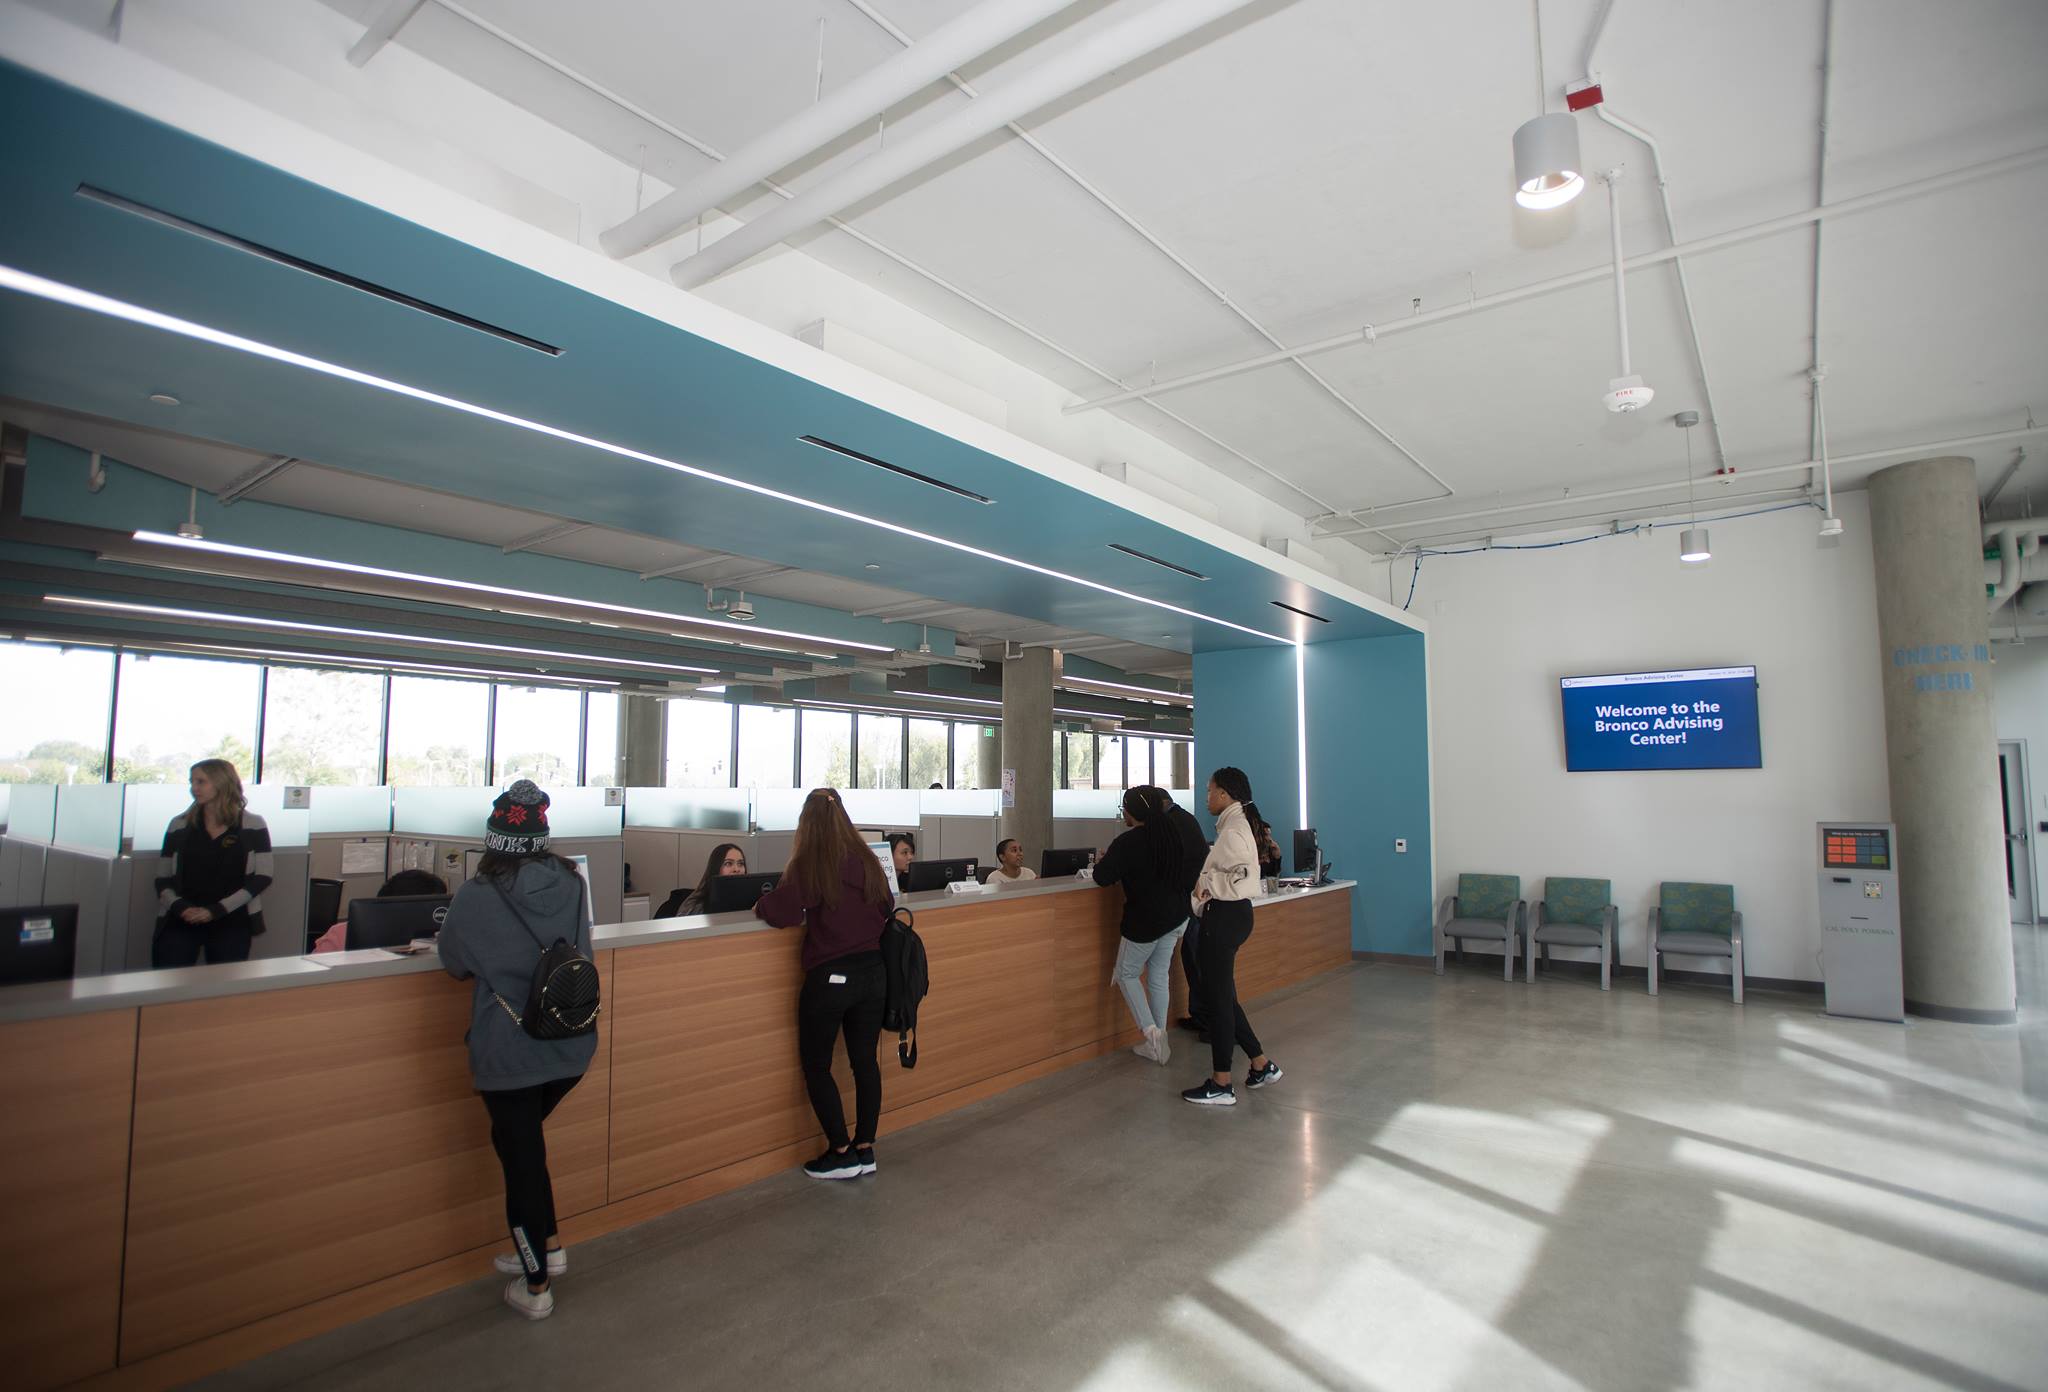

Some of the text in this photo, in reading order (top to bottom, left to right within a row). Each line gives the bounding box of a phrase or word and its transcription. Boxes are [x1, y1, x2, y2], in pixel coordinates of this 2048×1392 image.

[1616, 390, 1632, 398] FIRE
[1595, 700, 1720, 718] Welcome to the
[1595, 716, 1723, 733] Bronco Advising
[1630, 732, 1687, 745] Center!
[1862, 928, 1895, 936] POMONA
